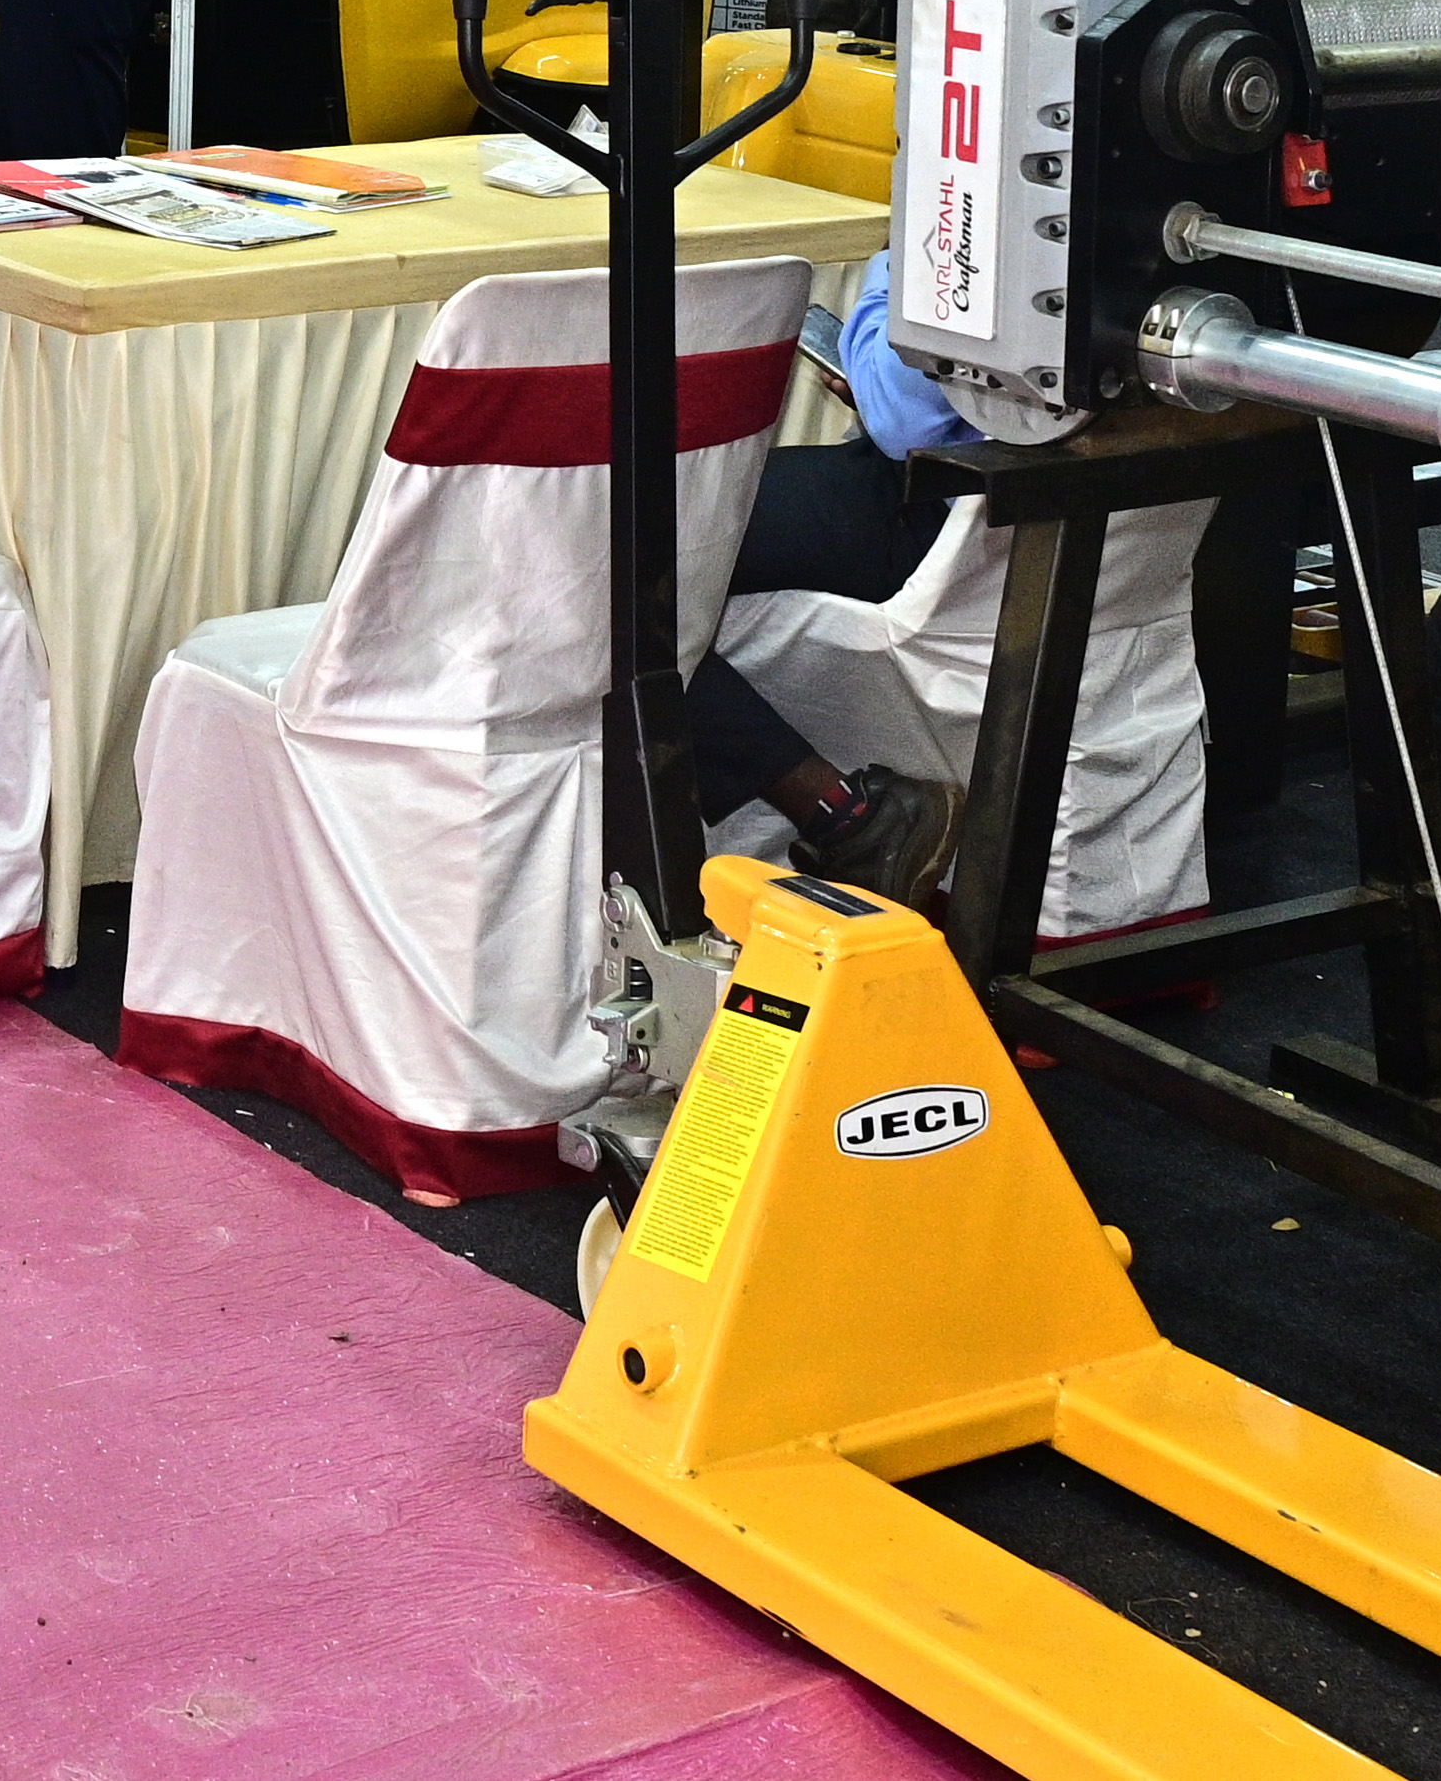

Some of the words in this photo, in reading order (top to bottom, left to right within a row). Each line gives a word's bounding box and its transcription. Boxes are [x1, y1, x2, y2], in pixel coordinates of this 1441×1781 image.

[941, 0, 982, 164] 2T
[937, 174, 955, 253] STAHL
[951, 191, 980, 313] Craftsman
[935, 257, 952, 321] CARL
[846, 1100, 979, 1145] JECL
